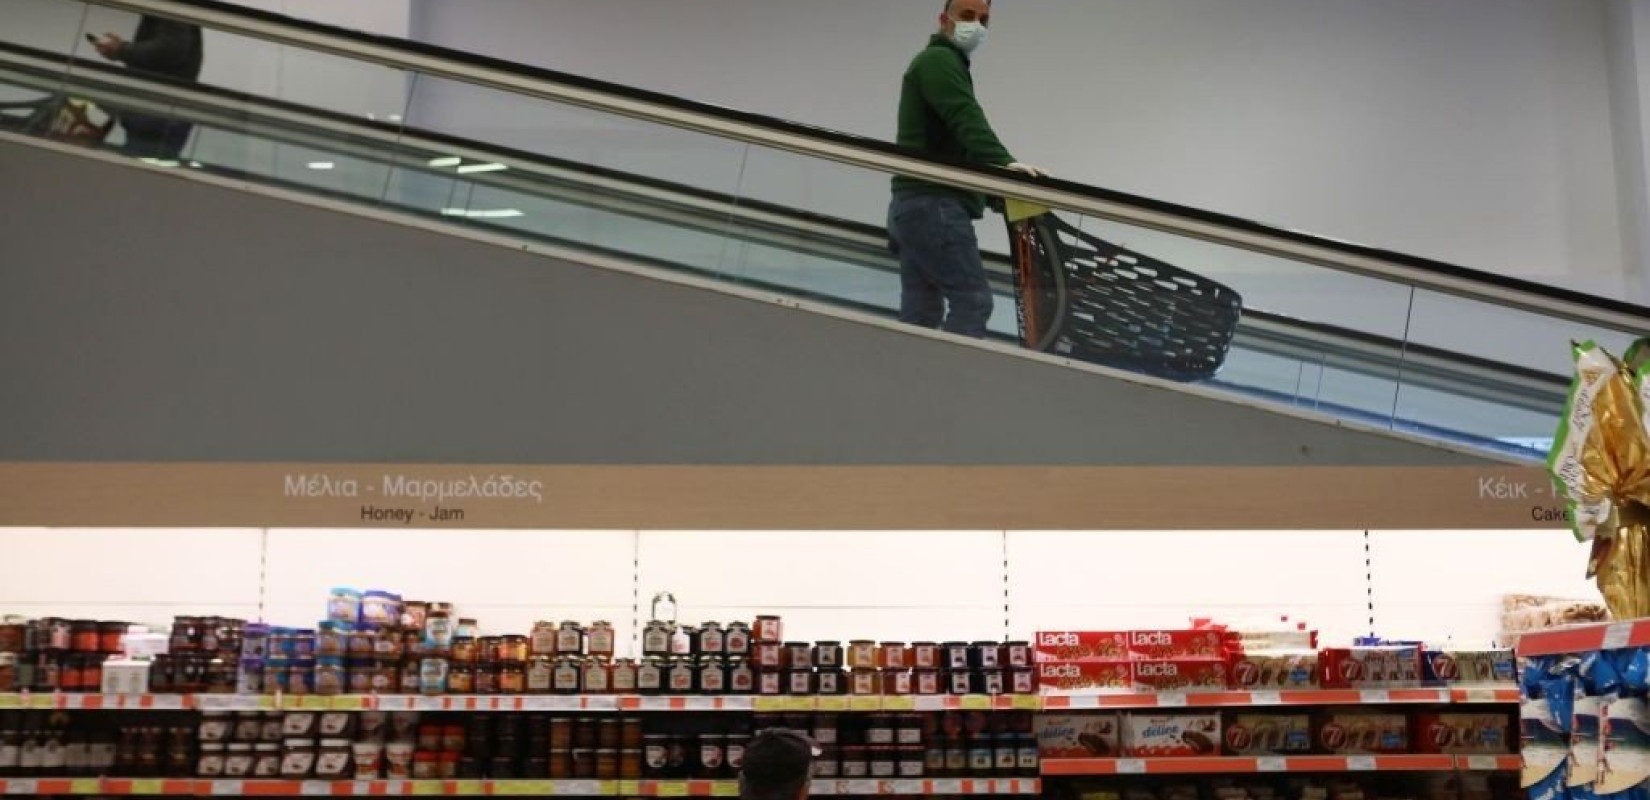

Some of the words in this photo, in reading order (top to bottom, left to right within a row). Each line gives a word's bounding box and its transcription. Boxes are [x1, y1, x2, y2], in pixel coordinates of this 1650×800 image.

[284, 475, 358, 497] Μέλια
[382, 475, 542, 501] Μαρμελάδες
[1479, 475, 1527, 498] Κέικ
[360, 505, 414, 523] Honey
[429, 506, 464, 520] Jam
